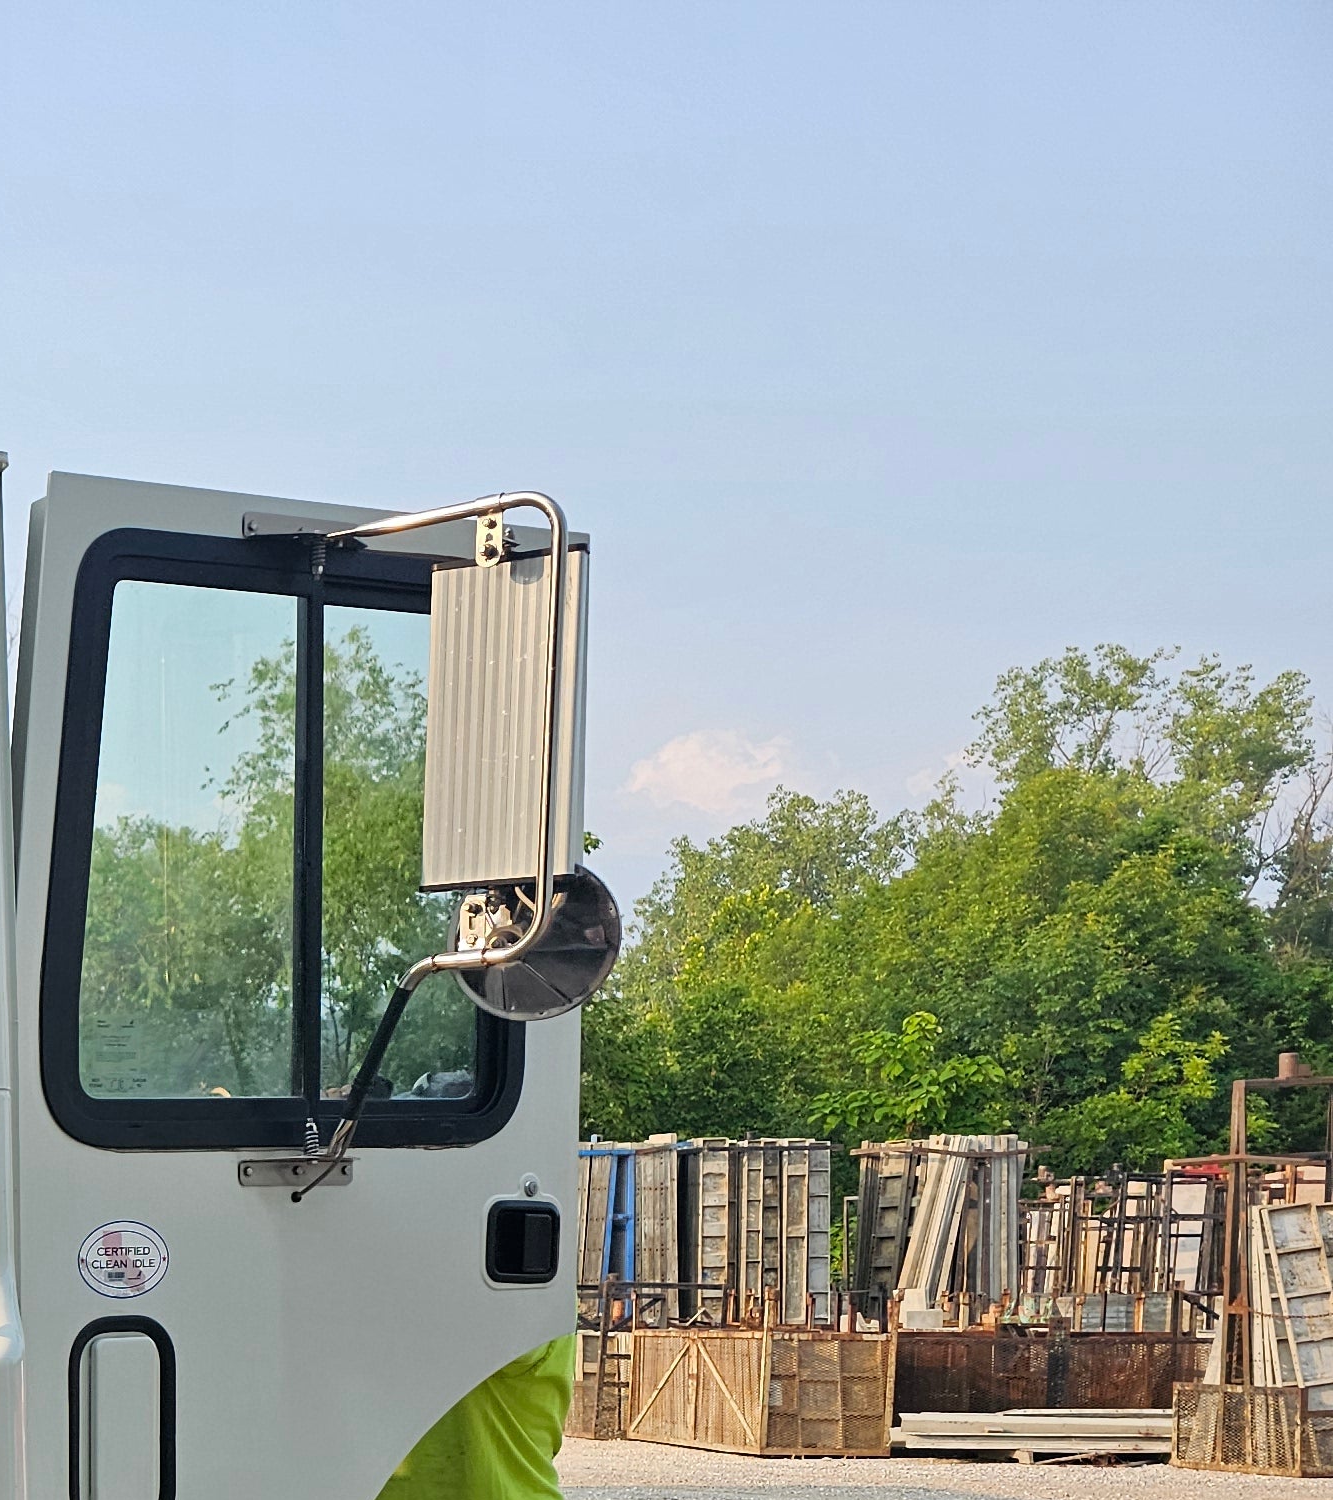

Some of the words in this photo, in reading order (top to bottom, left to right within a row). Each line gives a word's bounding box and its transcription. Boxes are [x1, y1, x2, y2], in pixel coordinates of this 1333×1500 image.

[97, 1247, 151, 1256] CERTIFIED
[92, 1259, 128, 1269] CLEAN
[132, 1258, 156, 1268] IDLE
